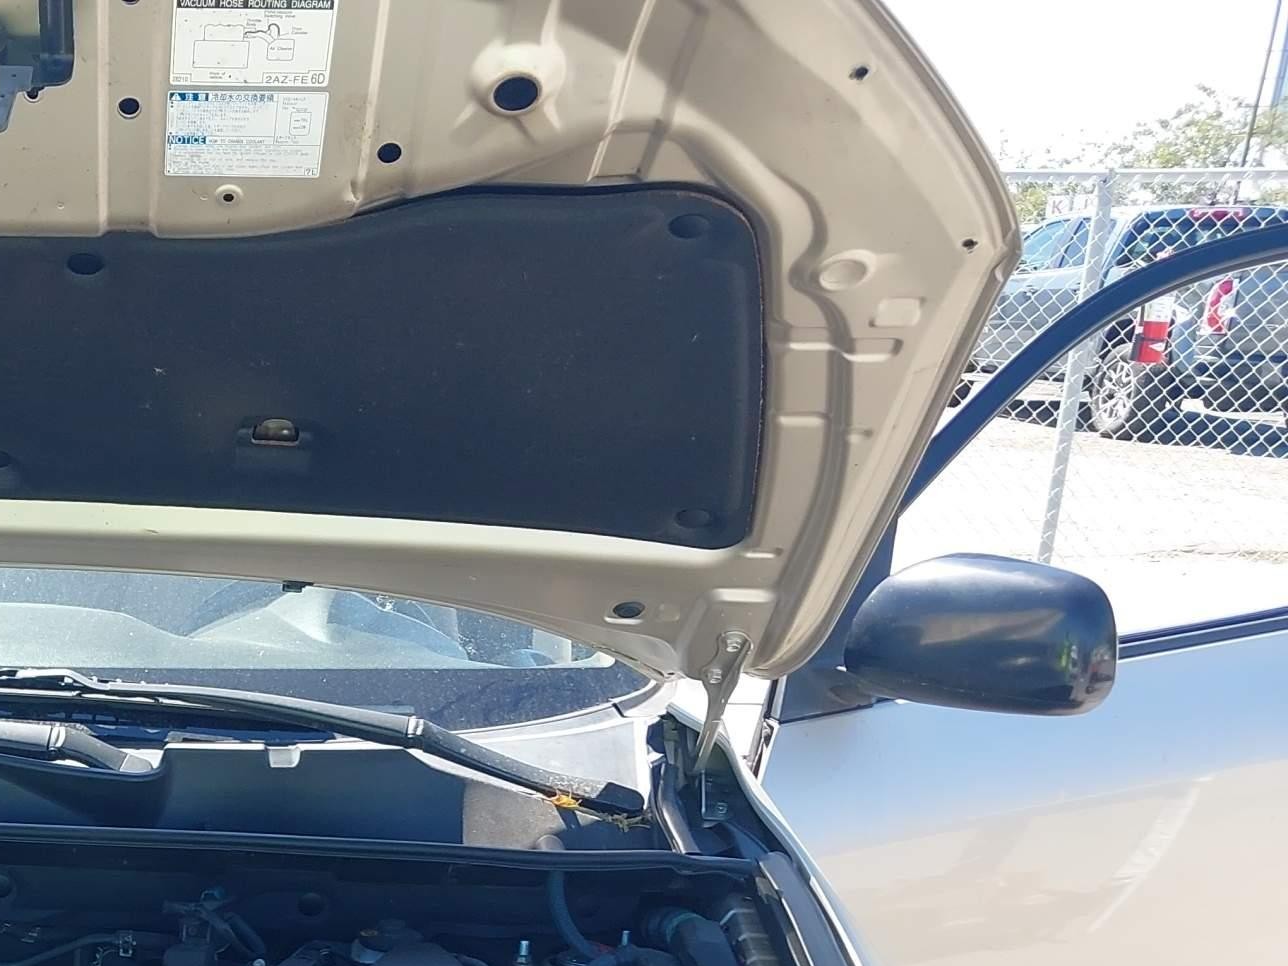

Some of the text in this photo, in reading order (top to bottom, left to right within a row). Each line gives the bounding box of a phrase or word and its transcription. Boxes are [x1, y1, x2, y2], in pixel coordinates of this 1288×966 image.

[220, 0, 244, 8] HOSE
[248, 0, 287, 9] ROUTING
[292, 0, 331, 9] DIAGRAM
[265, 73, 326, 84] 2AZ-FE 6D
[168, 135, 206, 144] NOTICE
